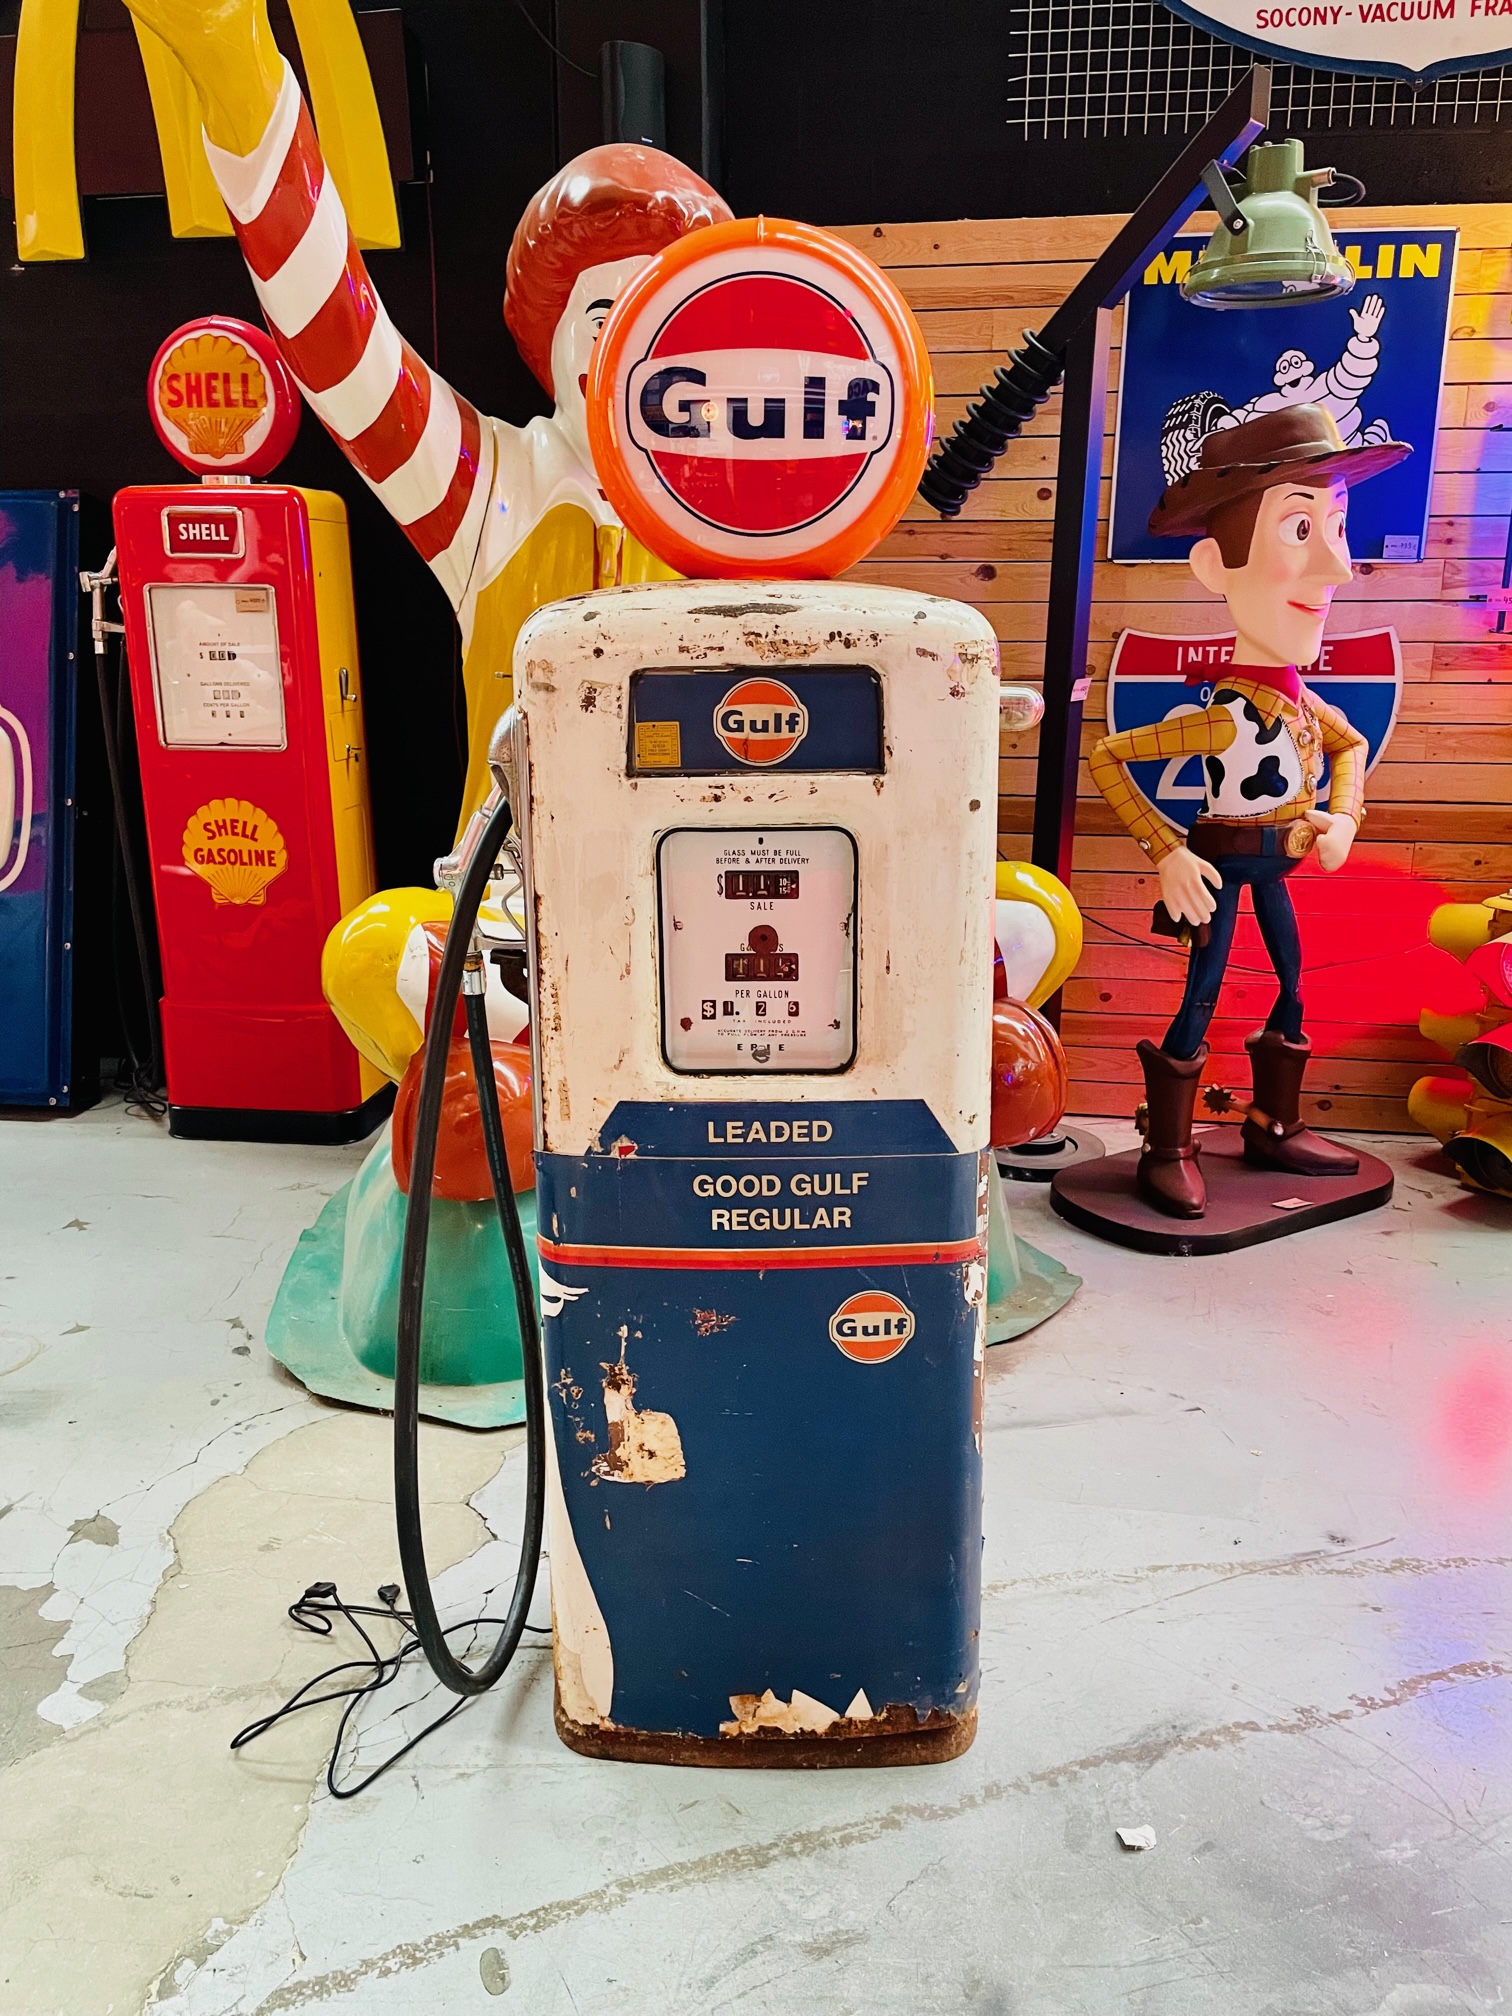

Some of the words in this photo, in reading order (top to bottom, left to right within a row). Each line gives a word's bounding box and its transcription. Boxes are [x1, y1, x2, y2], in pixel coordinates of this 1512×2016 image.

[1144, 244, 1442, 285] MLIN
[166, 372, 258, 408] SHELL
[639, 366, 880, 441] Gulf
[178, 523, 230, 541] SHELL
[1177, 646, 1334, 672] INTEE
[720, 709, 800, 734] Gulf
[203, 818, 259, 843] SHELL
[193, 847, 277, 868] GASOLINE
[749, 901, 774, 911] SALE
[735, 989, 750, 998] PER
[756, 989, 790, 998] GALLON
[707, 1120, 833, 1143] LEADED
[692, 1174, 782, 1198] GOOD
[789, 1172, 870, 1196] GULF
[711, 1206, 852, 1231] REGULAR
[835, 1317, 908, 1338] Gulf
